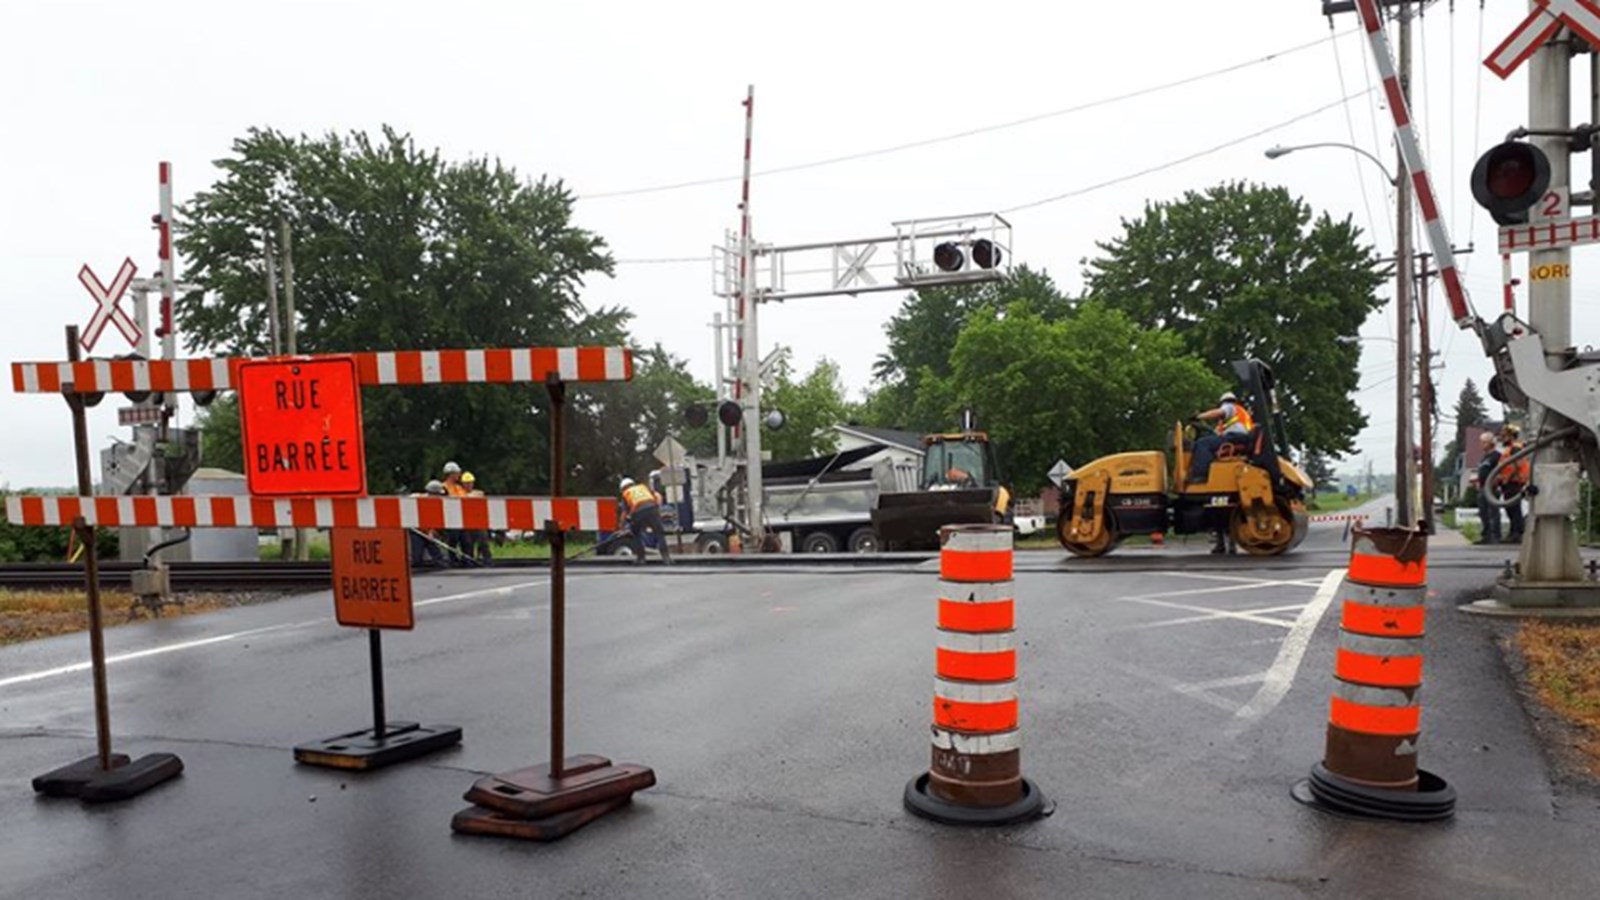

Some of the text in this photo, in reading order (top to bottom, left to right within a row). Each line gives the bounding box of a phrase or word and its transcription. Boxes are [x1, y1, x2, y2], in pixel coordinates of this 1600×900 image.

[1543, 191, 1561, 216] 2
[275, 380, 320, 409] RUE
[257, 436, 349, 472] BARRÉE
[1211, 496, 1229, 506] CAT
[353, 540, 383, 565] RUE
